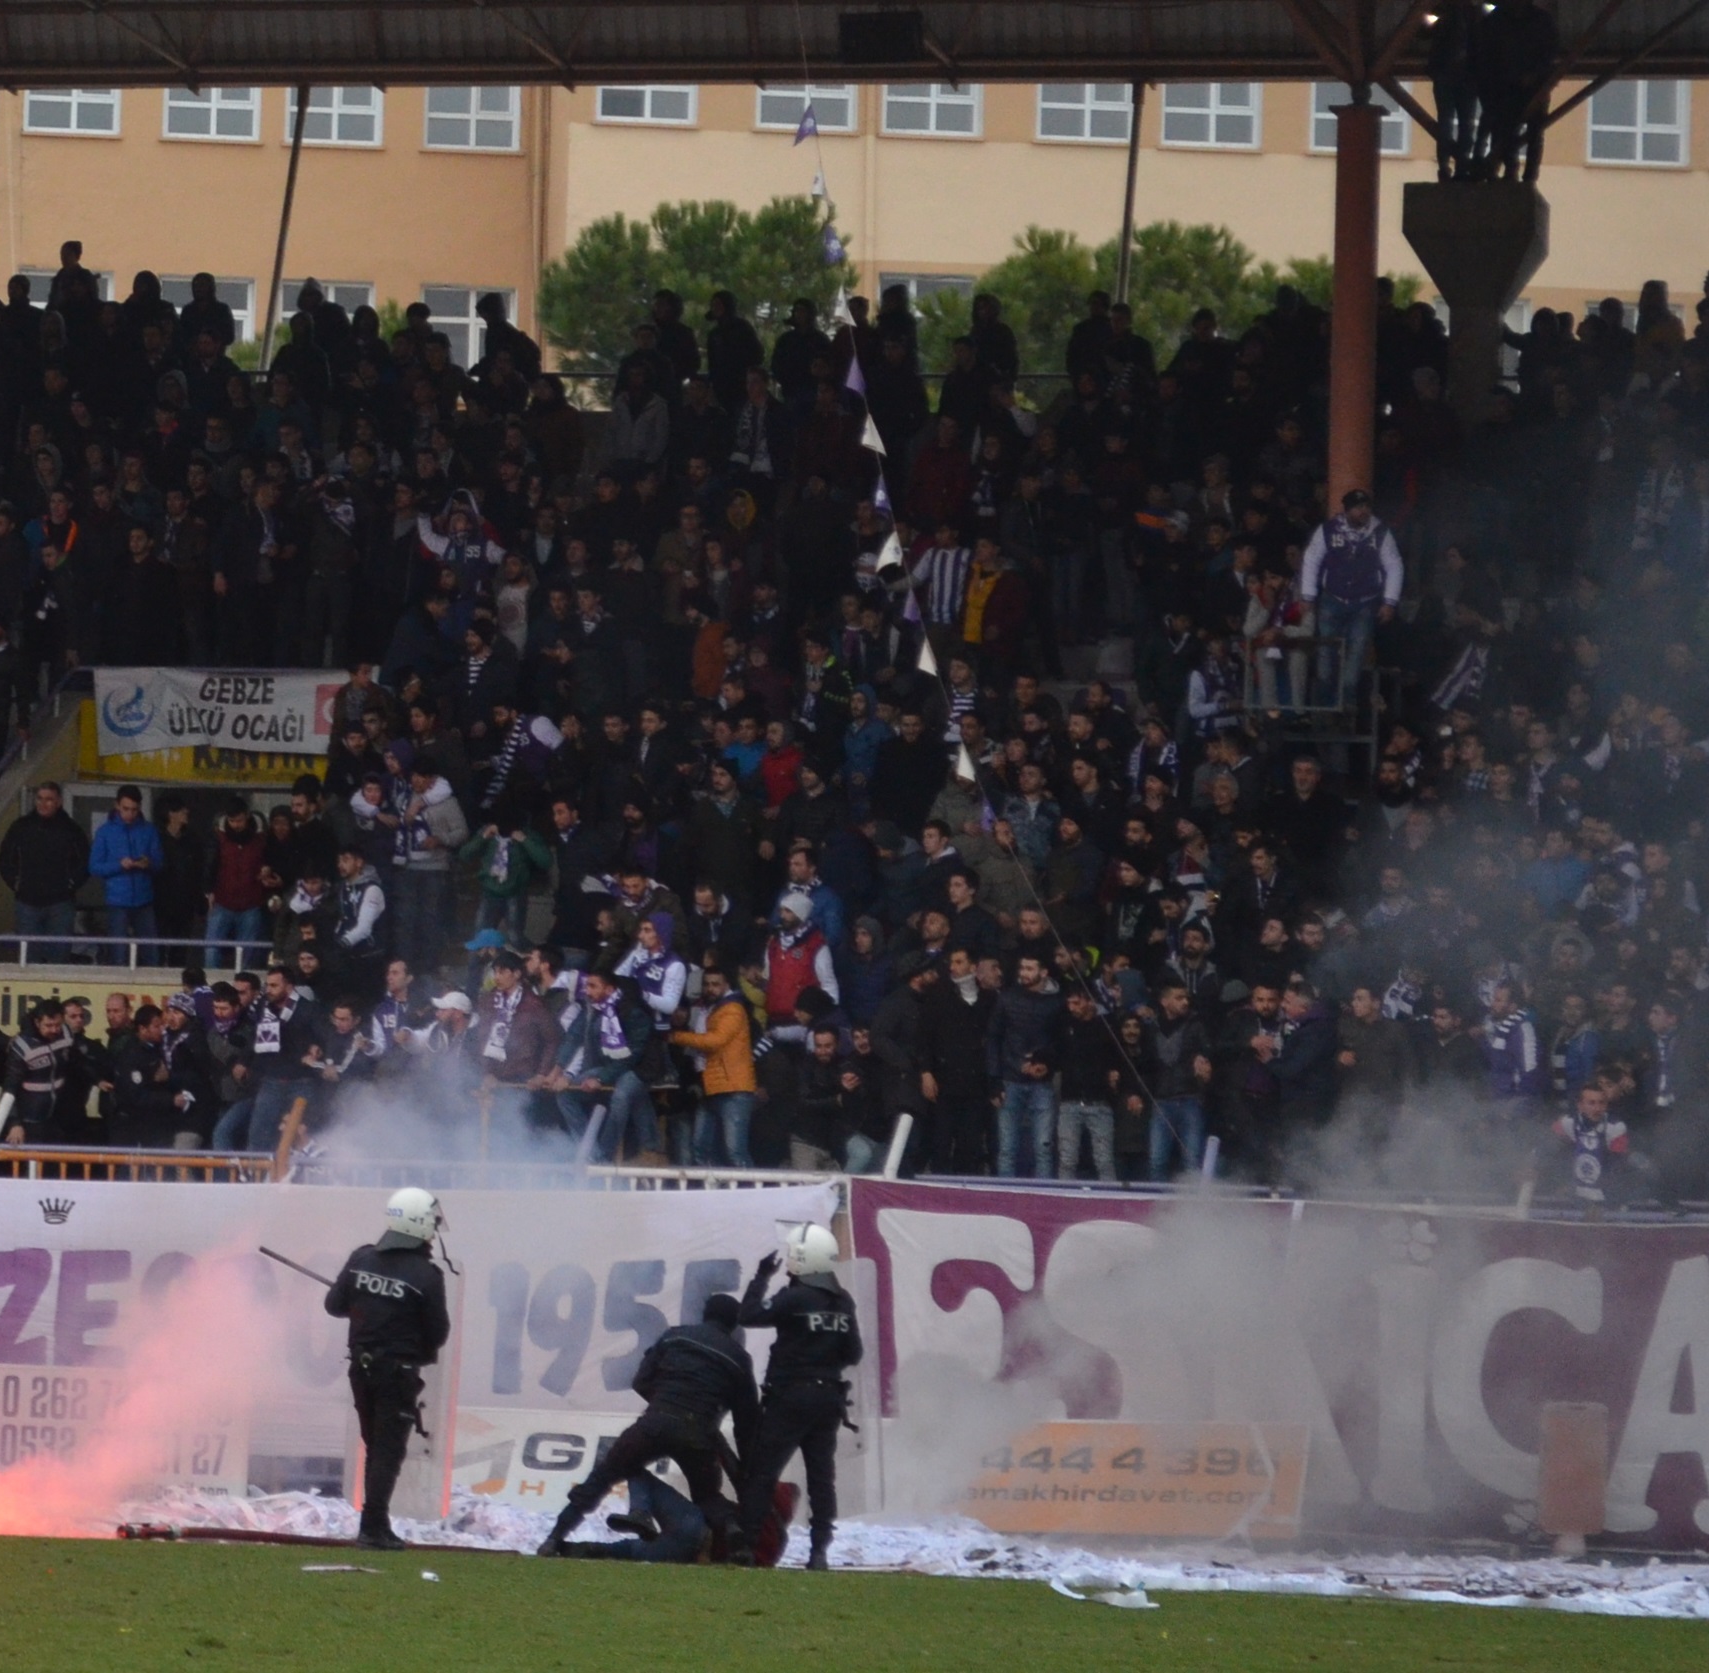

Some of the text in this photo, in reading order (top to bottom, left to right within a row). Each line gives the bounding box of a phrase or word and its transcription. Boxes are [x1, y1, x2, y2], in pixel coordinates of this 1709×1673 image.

[198, 676, 276, 705] GEBZE
[230, 708, 305, 743] OCAĞI
[2, 1375, 21, 1418] 0
[30, 1376, 89, 1421] 262
[192, 1433, 228, 1477] 27
[1110, 1446, 1147, 1475] 4
